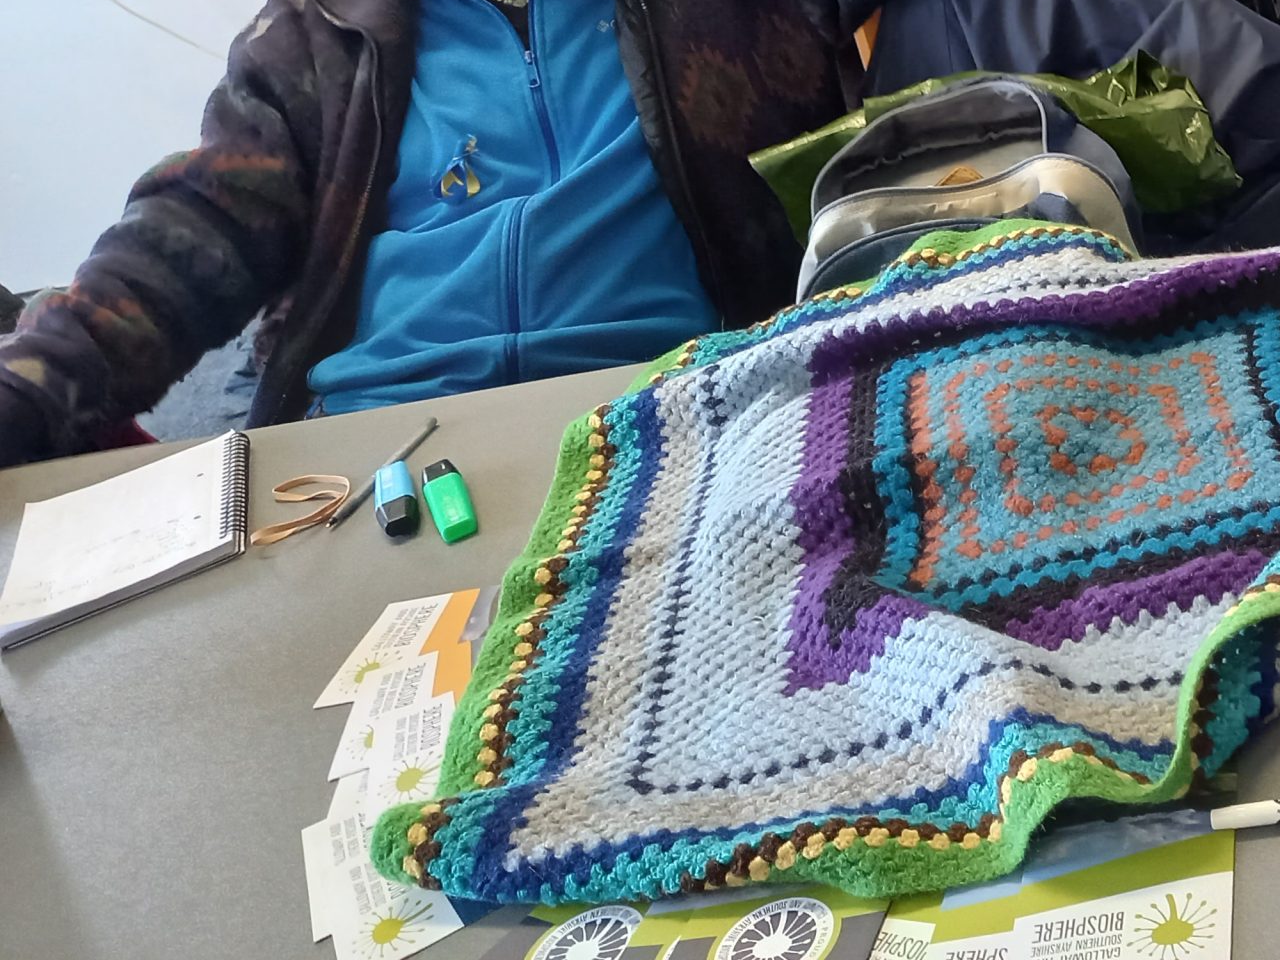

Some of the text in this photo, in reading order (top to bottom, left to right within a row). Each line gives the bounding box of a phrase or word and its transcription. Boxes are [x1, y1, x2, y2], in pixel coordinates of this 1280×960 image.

[1031, 911, 1125, 944] BIOSPHERE
[1030, 934, 1122, 958] SOUTHERN AYRSHIRE
